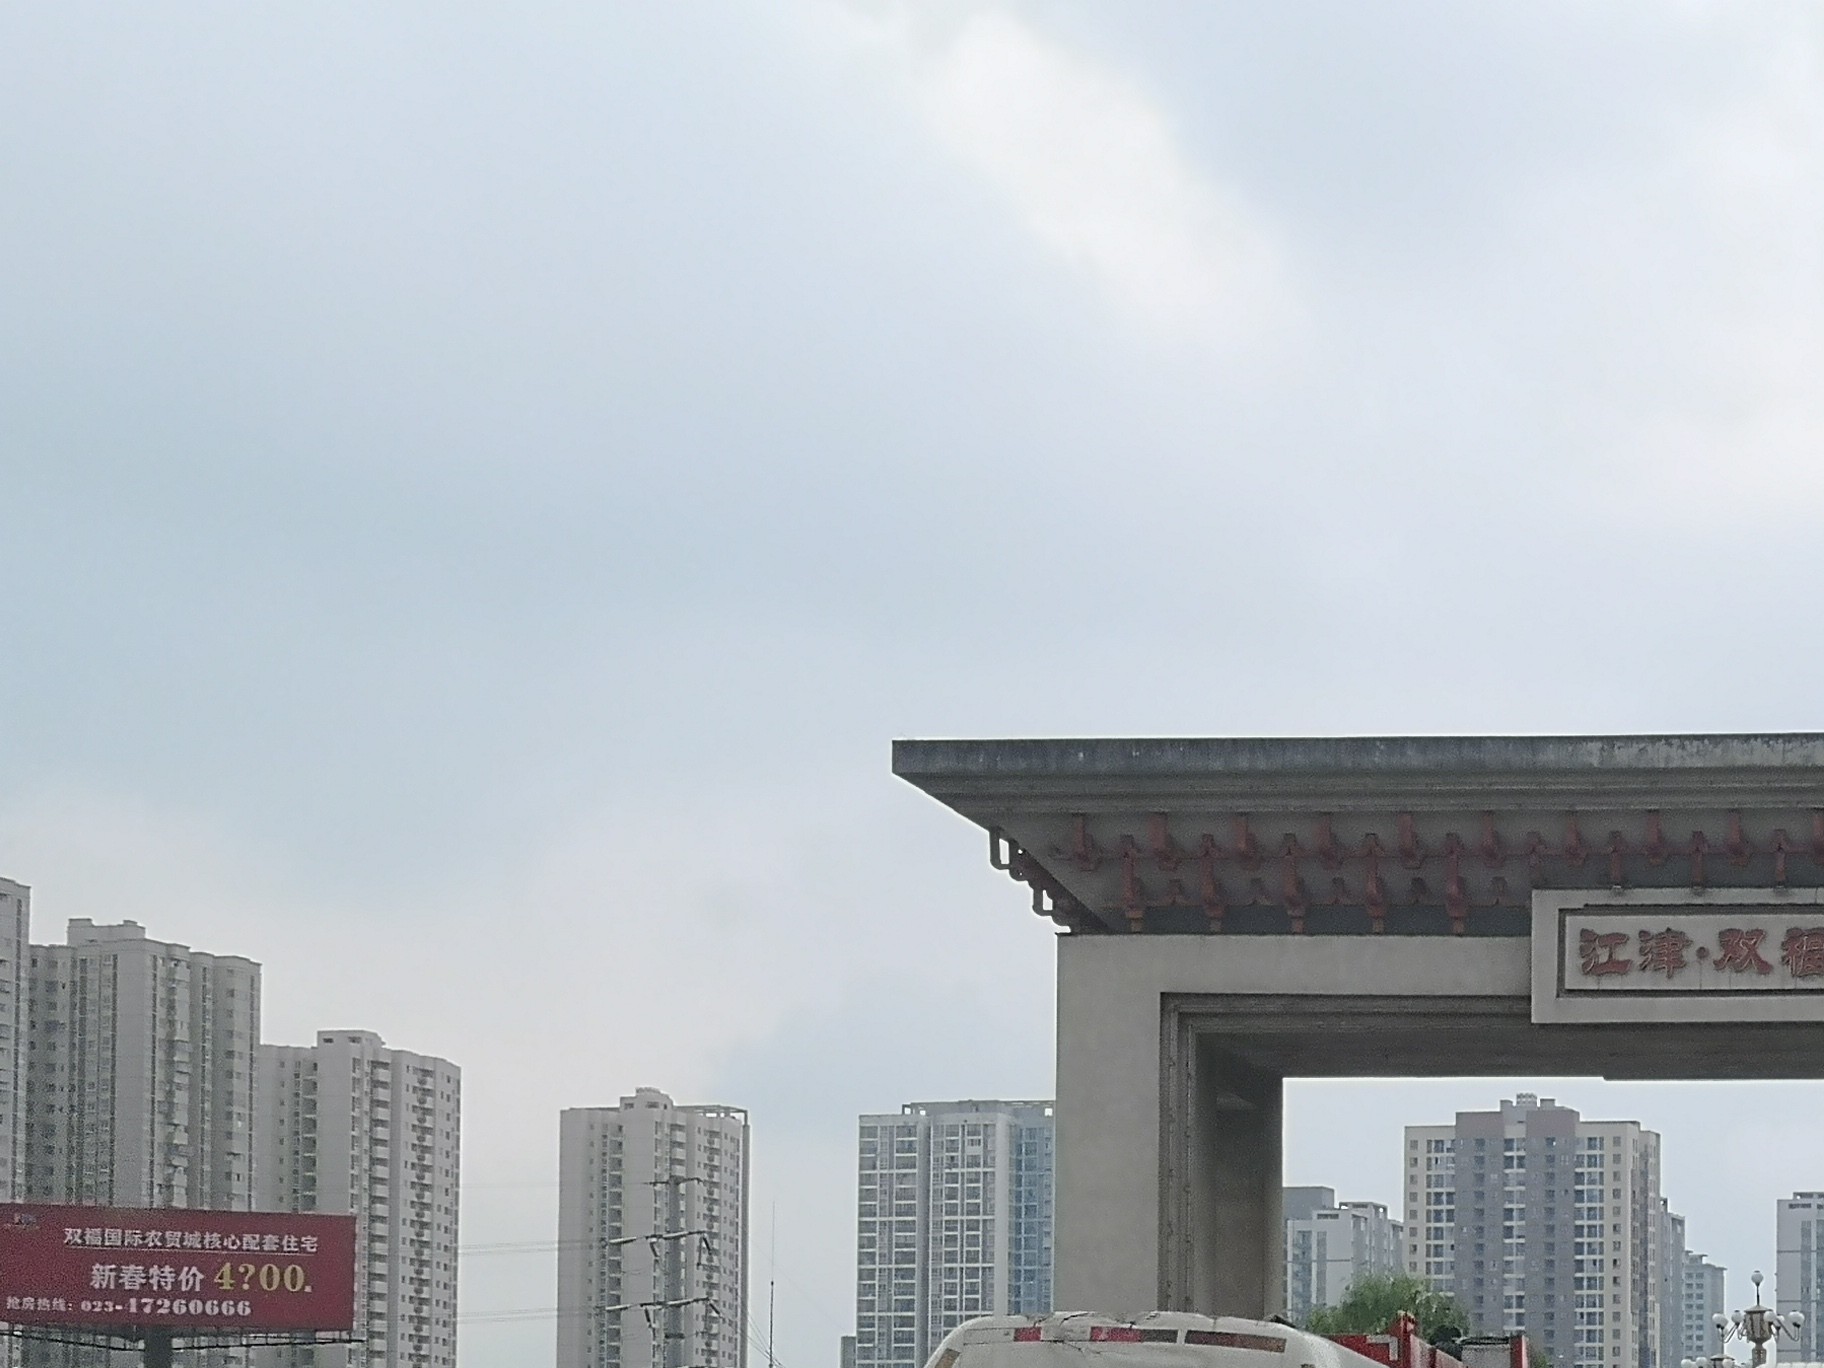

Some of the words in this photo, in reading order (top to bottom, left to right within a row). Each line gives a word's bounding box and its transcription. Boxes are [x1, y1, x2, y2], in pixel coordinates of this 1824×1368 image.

[63, 1227, 318, 1252] 双福国际农贸城核心配套住宅
[90, 1263, 204, 1292] 新春特价
